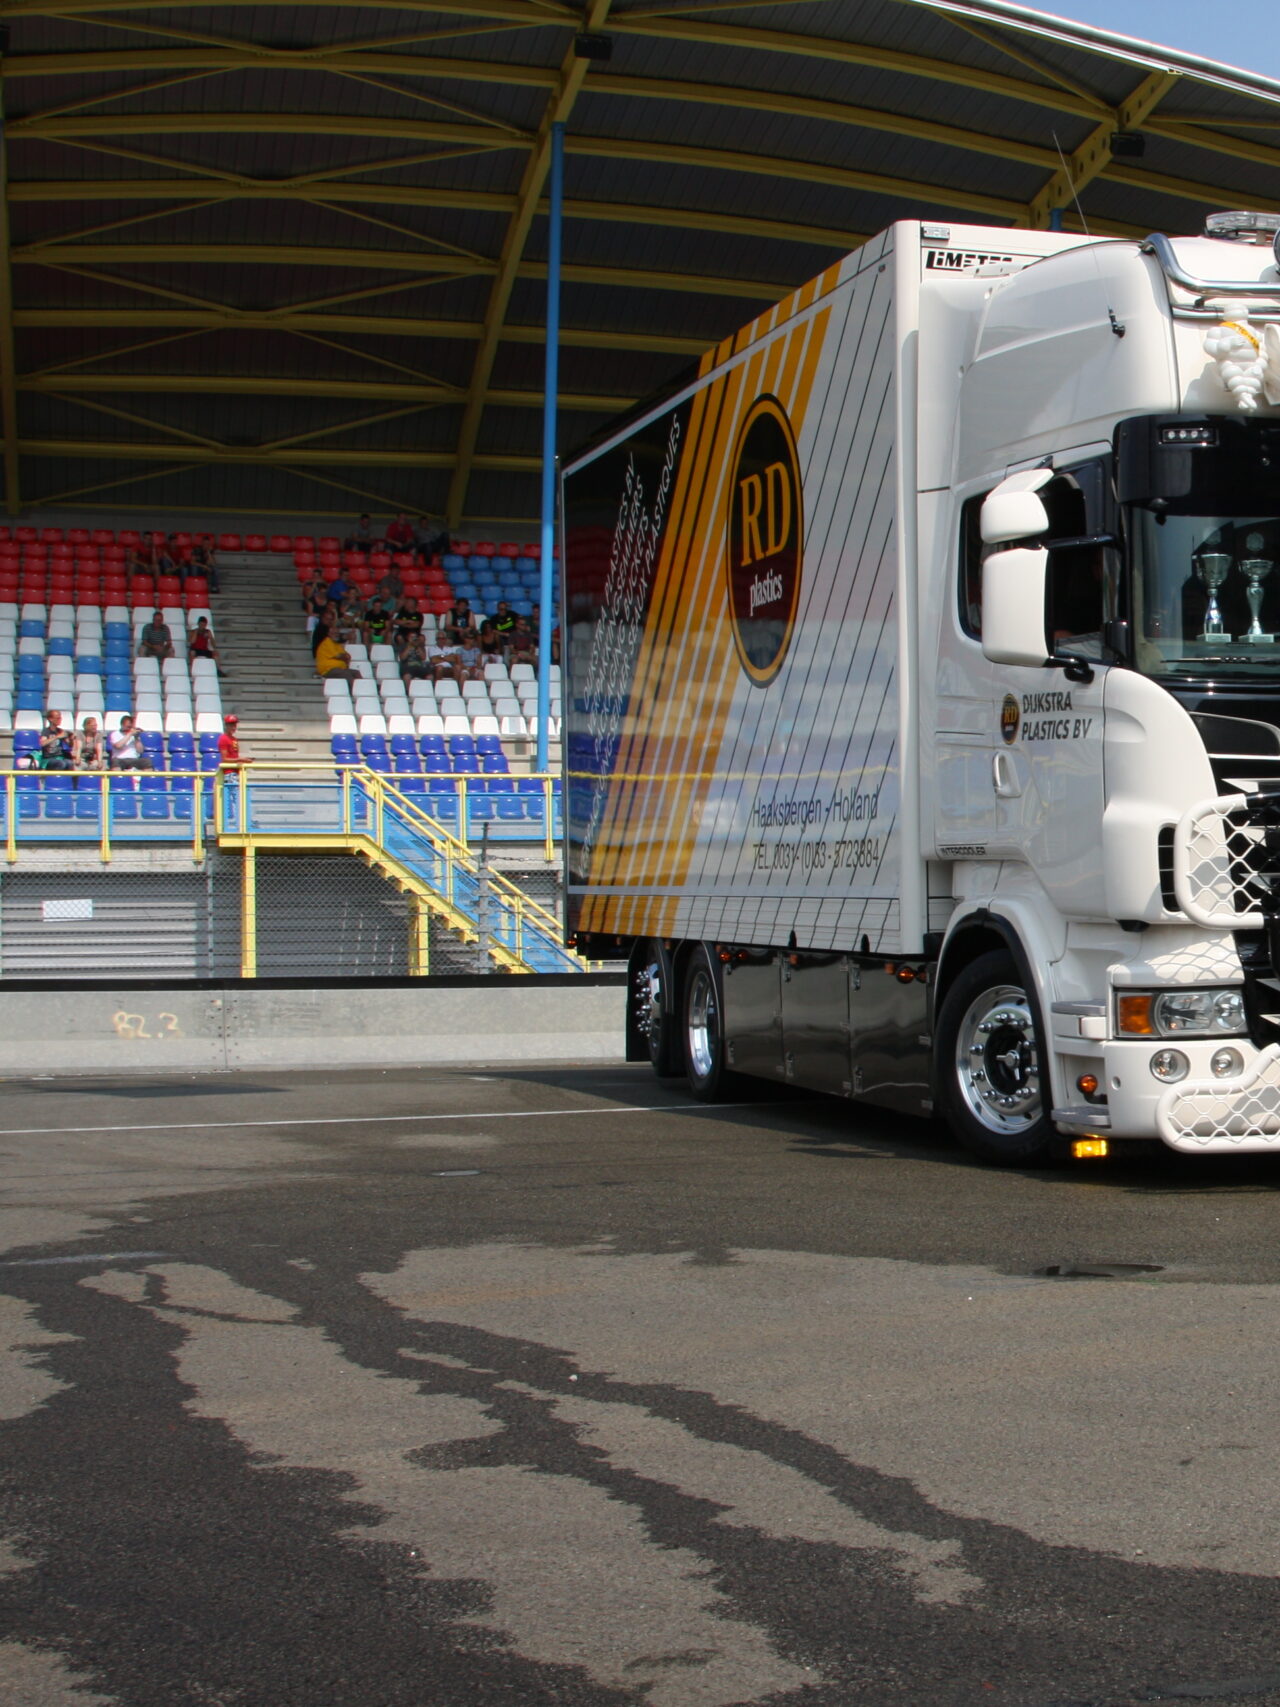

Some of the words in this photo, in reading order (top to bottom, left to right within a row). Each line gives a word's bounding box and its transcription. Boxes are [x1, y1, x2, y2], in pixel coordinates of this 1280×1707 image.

[605, 492, 628, 605] PLASTICS
[626, 452, 635, 495] BV
[628, 571, 648, 655] SEAUX
[645, 413, 680, 574] PLASTIQUES
[740, 461, 791, 567] RD
[624, 507, 648, 621] BUCKETS
[750, 568, 783, 617] plastics
[1021, 720, 1070, 741] PLASTICS
[1072, 718, 1092, 739] BV
[1022, 691, 1073, 714] DIJKSTRA
[753, 794, 822, 834] Haaksbergen
[832, 784, 879, 823] Holland
